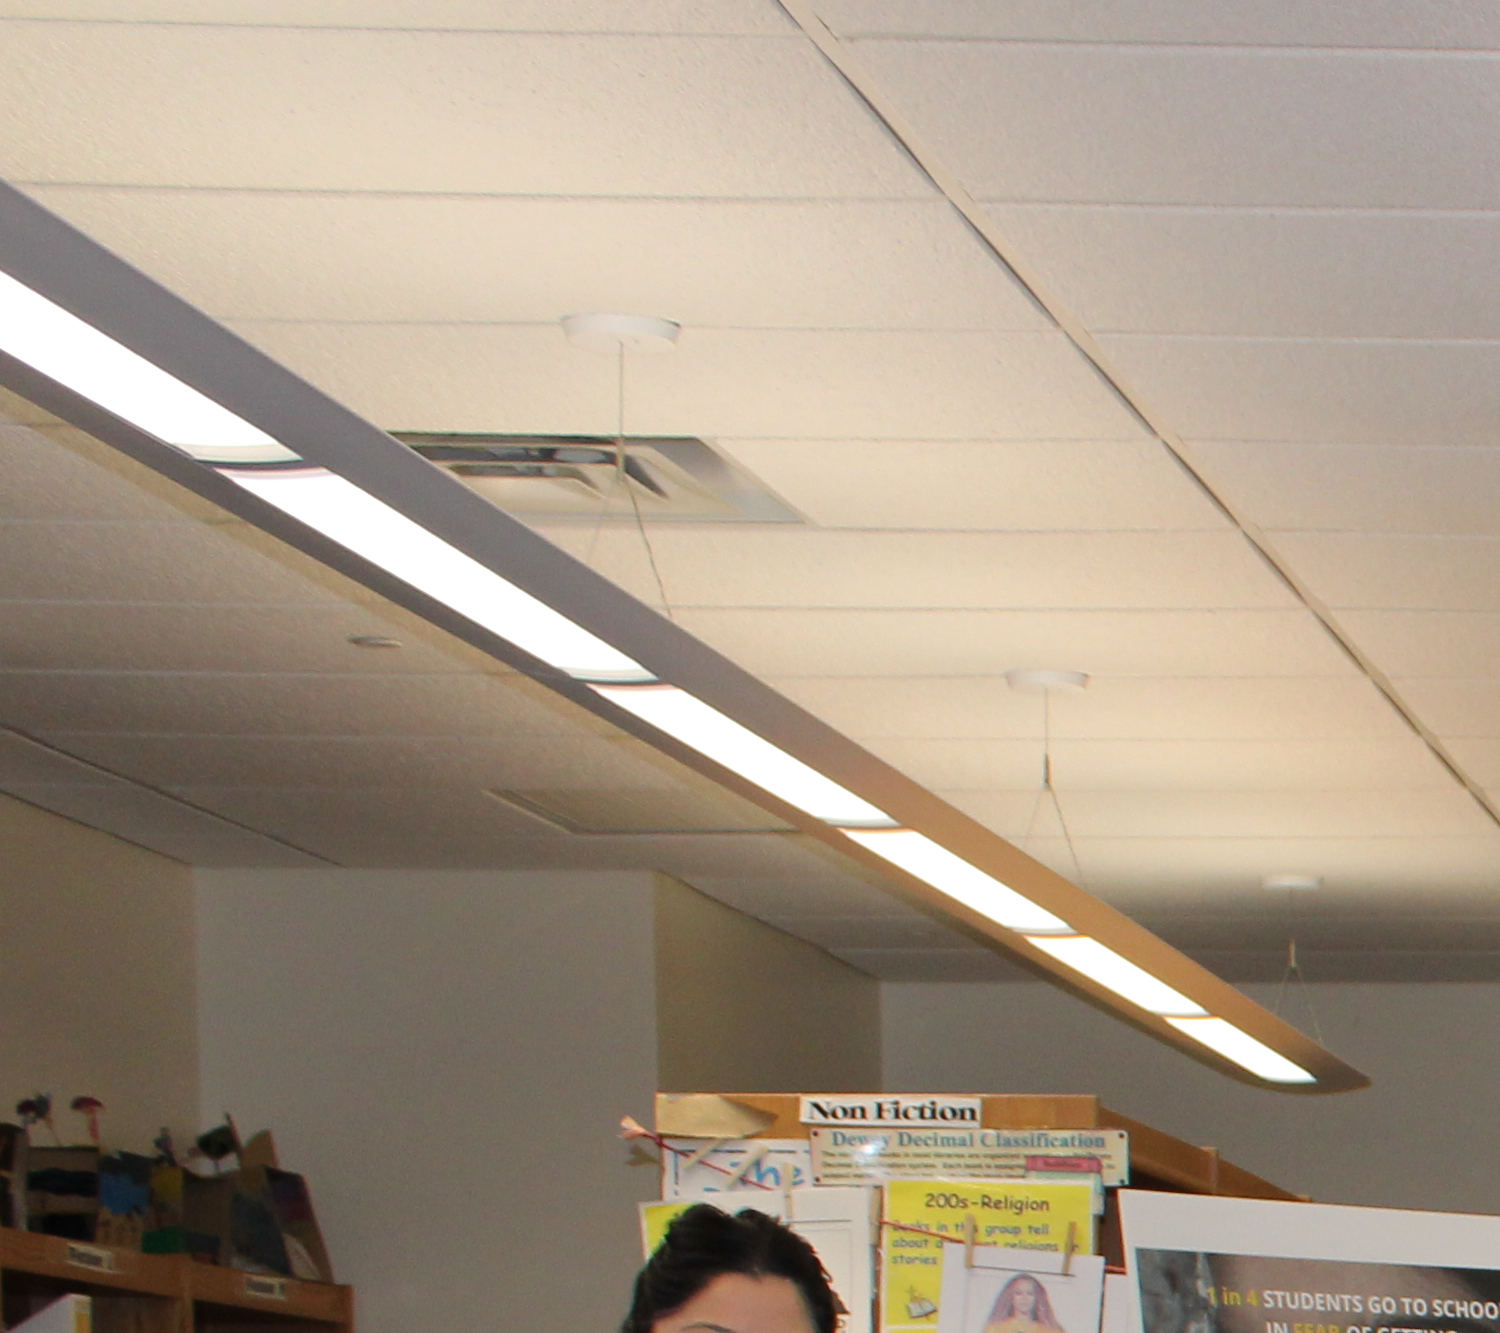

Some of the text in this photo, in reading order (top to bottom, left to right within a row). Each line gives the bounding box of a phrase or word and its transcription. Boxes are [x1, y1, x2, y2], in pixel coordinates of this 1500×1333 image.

[809, 1101, 978, 1122] Non Fiction
[831, 1130, 1106, 1151] Dewy Decimal Classification
[924, 1193, 1050, 1214] 200s-Religion
[985, 1225, 1022, 1237] group
[1028, 1224, 1050, 1235] tell
[1222, 1286, 1242, 1306] in
[1263, 1290, 1363, 1313] STUDENTS
[1368, 1296, 1396, 1315] GO
[1401, 1297, 1427, 1317] TO
